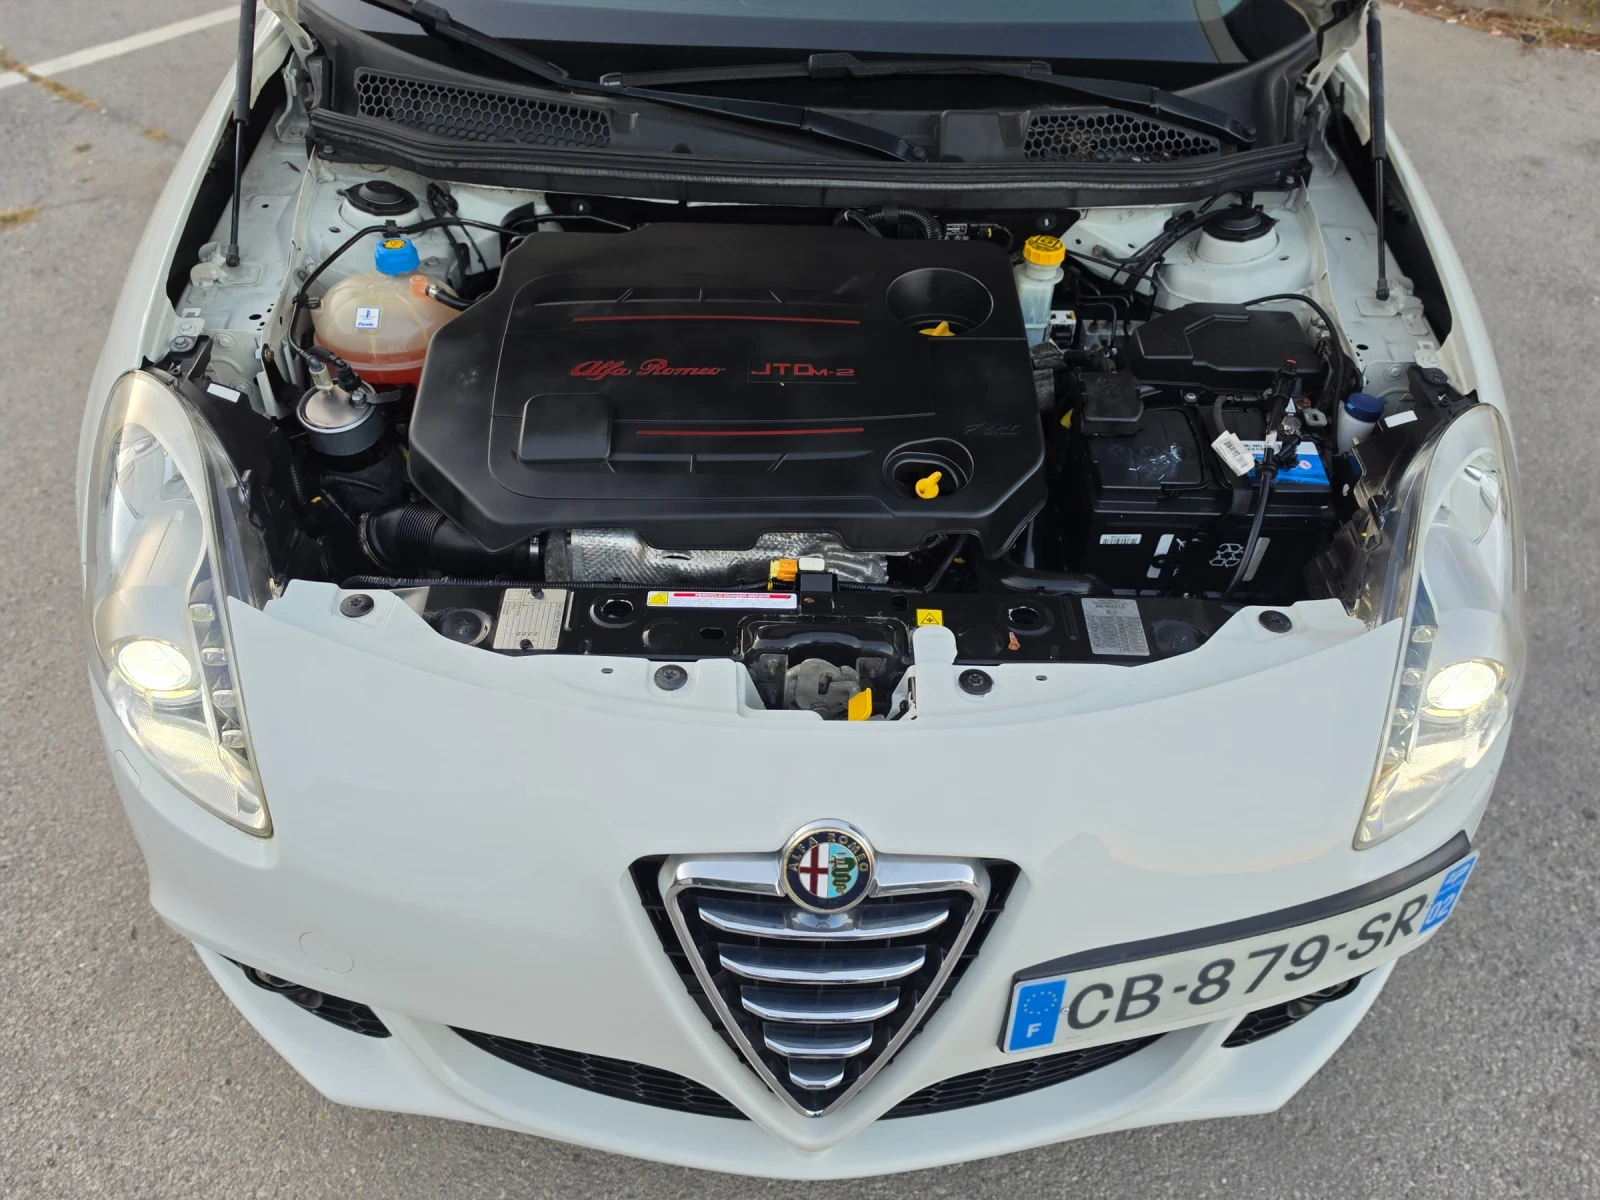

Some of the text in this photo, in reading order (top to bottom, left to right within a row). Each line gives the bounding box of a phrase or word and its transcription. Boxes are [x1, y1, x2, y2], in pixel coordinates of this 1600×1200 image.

[570, 358, 726, 381] Alfa Romeo
[788, 832, 869, 873] ALFA ROMEO
[1424, 892, 1456, 925] 02
[1067, 893, 1428, 1031] CB-879-SR
[1026, 1022, 1042, 1039] F
